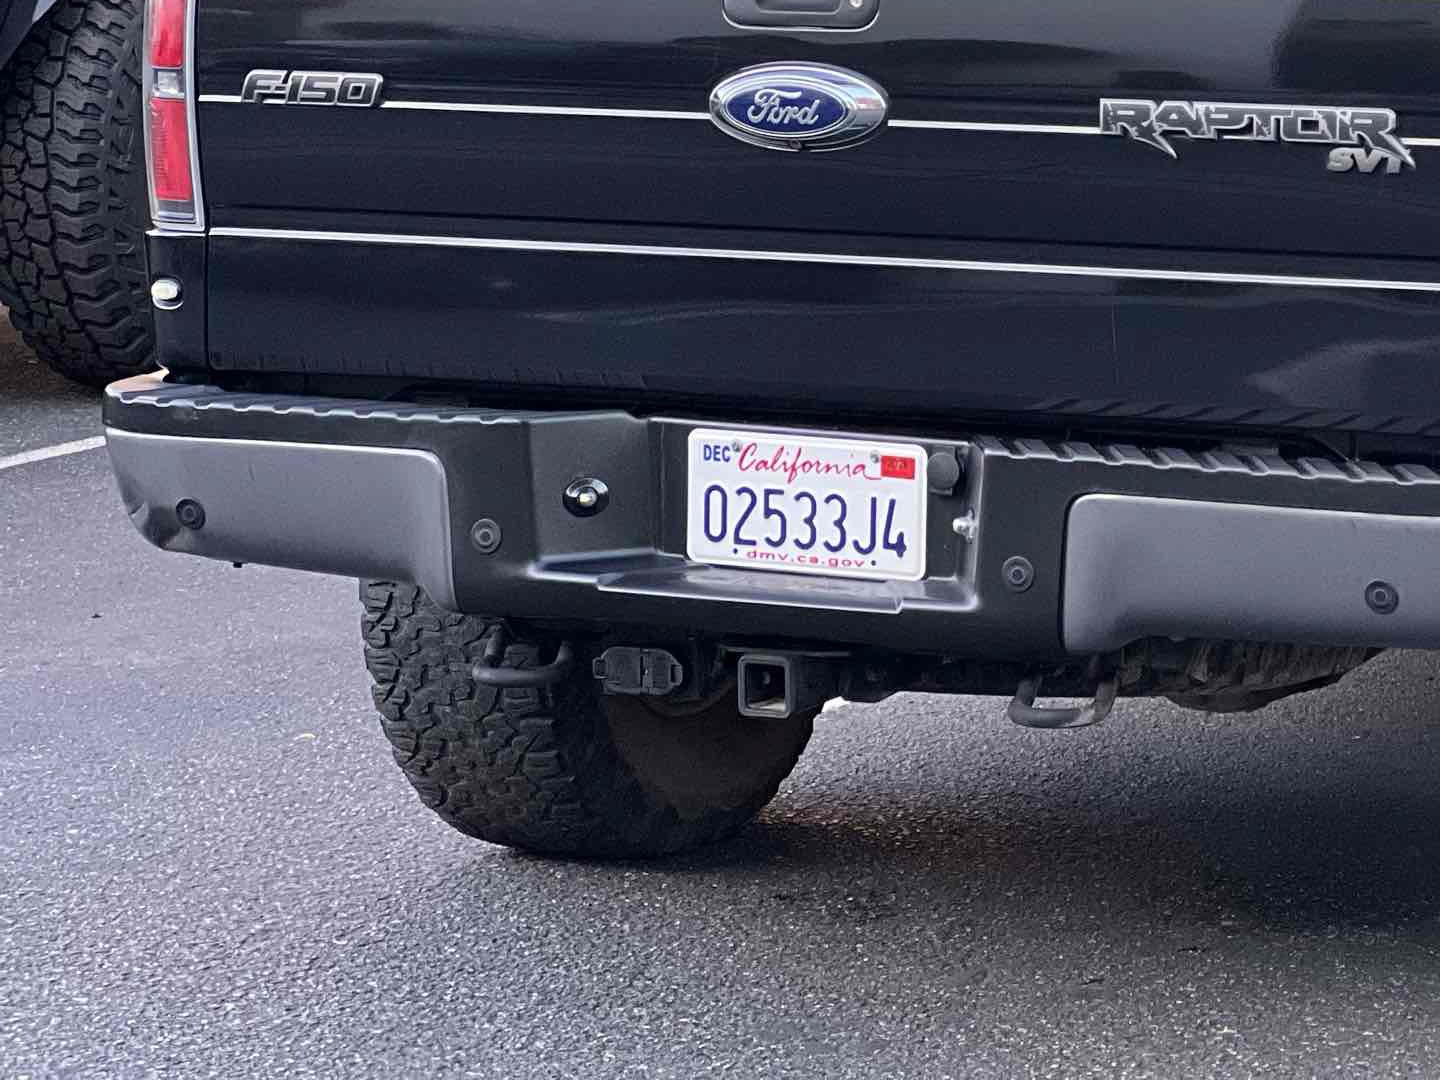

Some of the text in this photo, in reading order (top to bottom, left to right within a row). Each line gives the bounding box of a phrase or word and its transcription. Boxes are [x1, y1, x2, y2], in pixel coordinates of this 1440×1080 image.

[240, 69, 384, 107] F-150
[746, 88, 821, 126] Ford
[1100, 98, 1416, 169] RAPTOR
[1327, 147, 1402, 174] SVT
[703, 444, 731, 463] DEC
[738, 442, 882, 483] California
[703, 484, 907, 558] 02533J4
[746, 549, 866, 568] dmv.ca.gov
